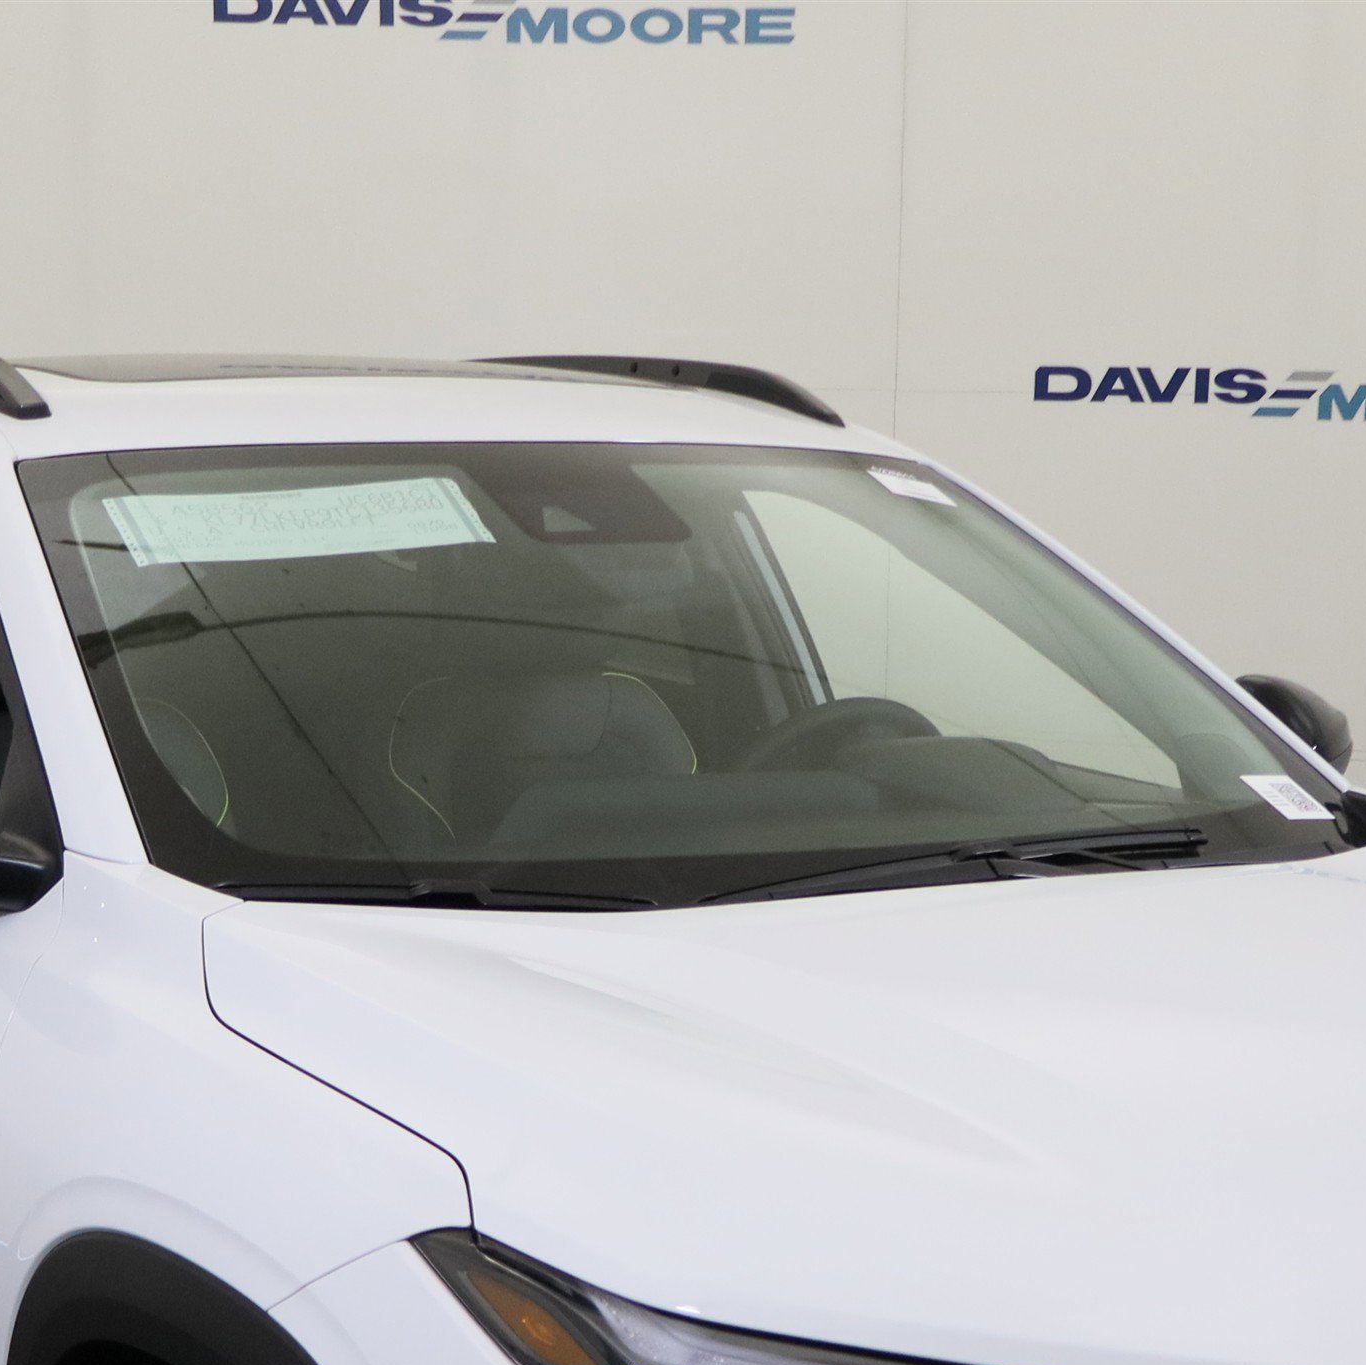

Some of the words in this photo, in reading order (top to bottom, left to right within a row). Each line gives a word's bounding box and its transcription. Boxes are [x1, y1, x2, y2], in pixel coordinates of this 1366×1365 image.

[213, 0, 454, 27] DAVIS
[506, 7, 796, 44] MOORE
[1033, 366, 1268, 404] DAVIS
